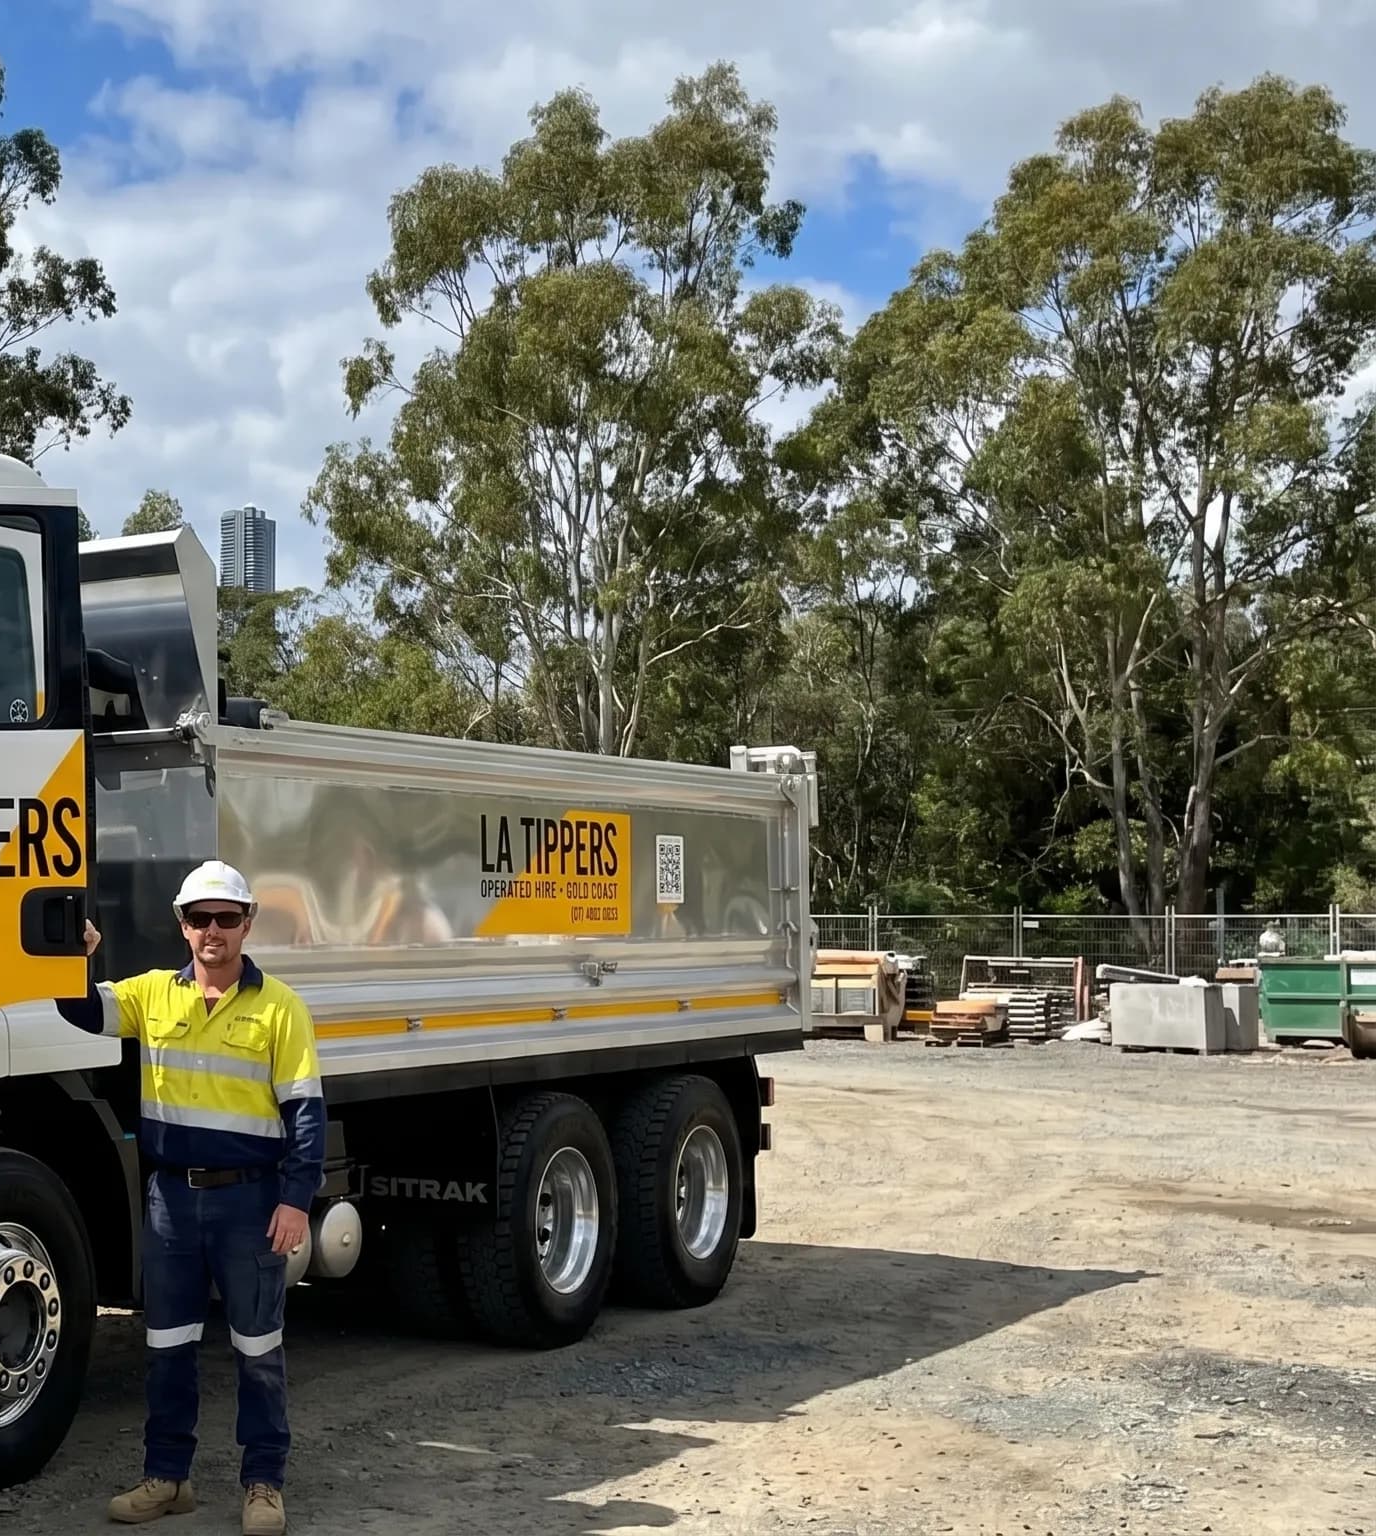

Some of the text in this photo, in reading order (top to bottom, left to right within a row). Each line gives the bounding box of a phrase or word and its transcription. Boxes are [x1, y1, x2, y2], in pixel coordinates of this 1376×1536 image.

[480, 814, 619, 877] LA TIPPERS
[481, 879, 532, 899] OPERATED
[535, 880, 557, 899] HIRE
[566, 882, 589, 900] GOLD
[591, 882, 618, 900] COAST
[370, 1176, 488, 1204] SITRAK
